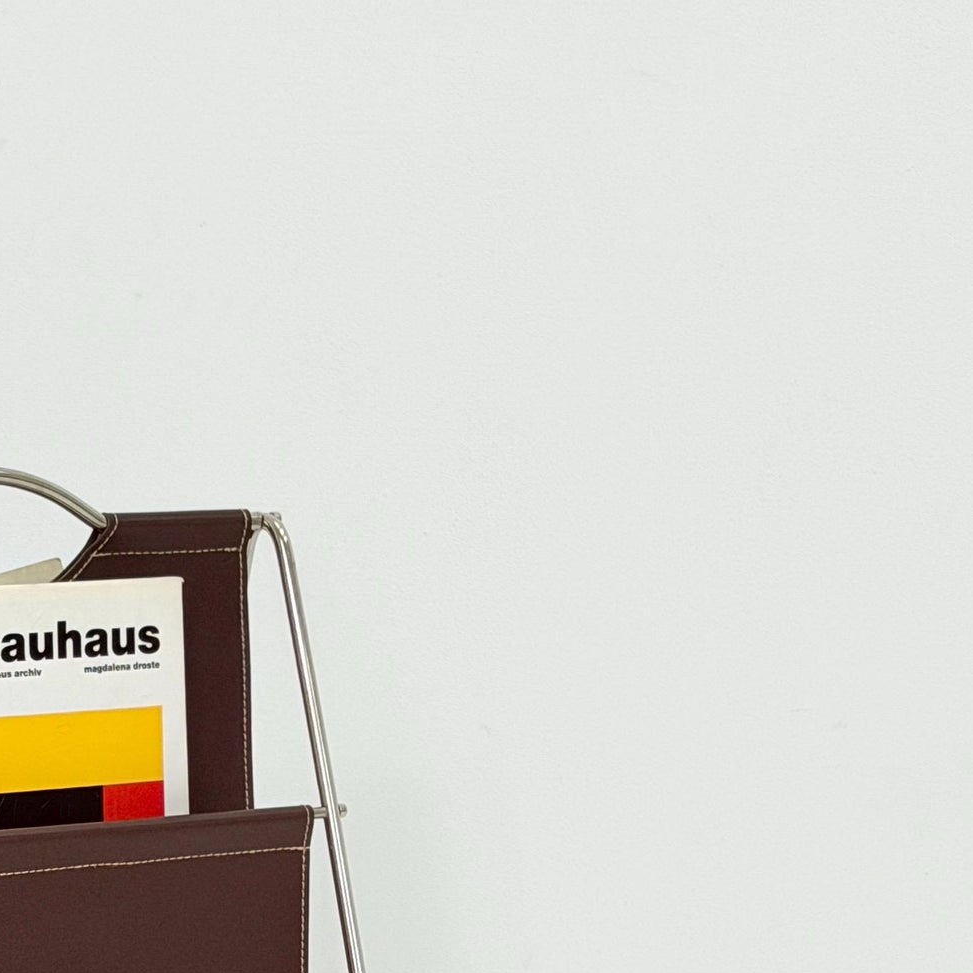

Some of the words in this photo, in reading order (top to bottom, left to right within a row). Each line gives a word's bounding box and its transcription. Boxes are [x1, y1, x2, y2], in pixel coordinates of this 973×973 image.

[13, 667, 42, 678] archiv
[83, 663, 131, 673] magdalena
[132, 660, 161, 670] droste
